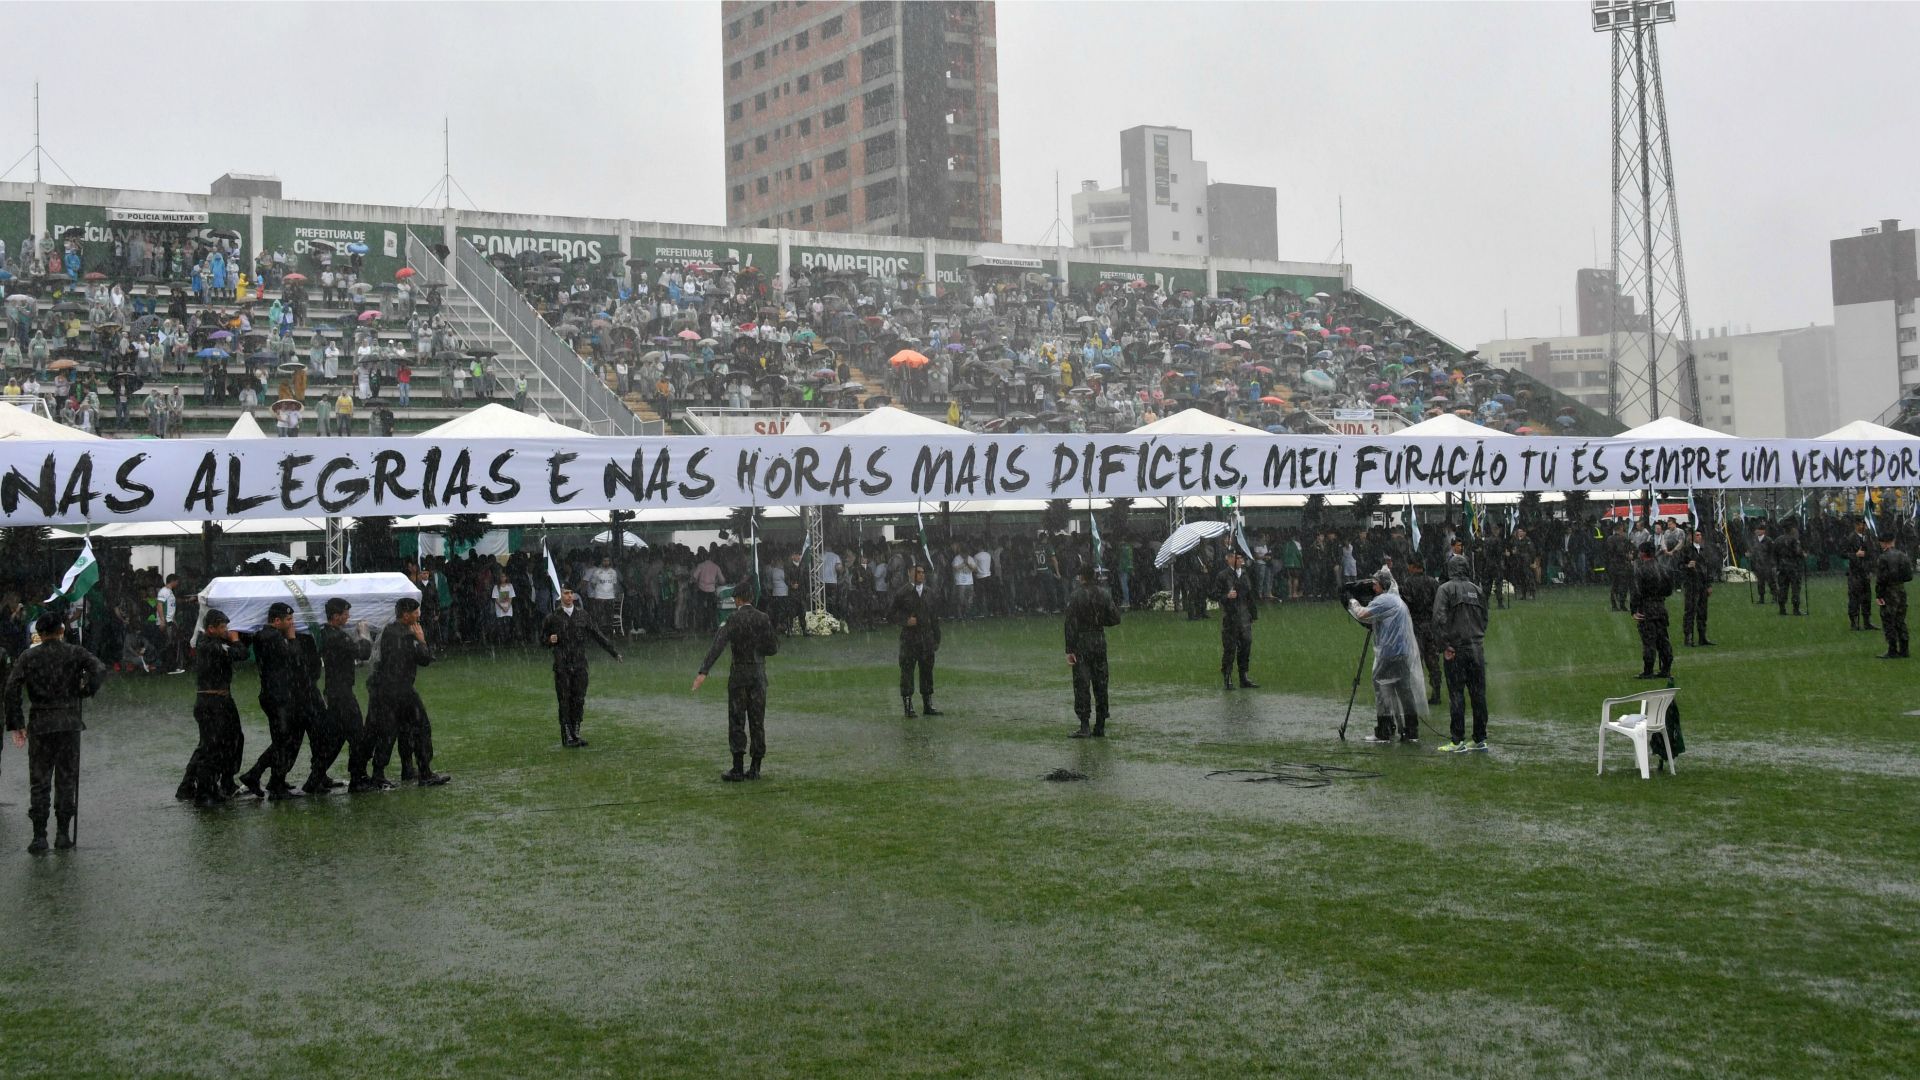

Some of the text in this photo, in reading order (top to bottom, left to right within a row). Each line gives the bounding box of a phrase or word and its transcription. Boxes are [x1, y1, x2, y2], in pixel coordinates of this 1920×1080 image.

[54, 221, 114, 242] PÍCIA
[296, 227, 366, 240] PREFEITURA DE
[655, 247, 713, 258] PREFEITURA DE
[801, 252, 909, 278] BOMBEIROS
[754, 416, 791, 435] SAÍ
[1370, 423, 1380, 436] 3
[1, 450, 155, 518] NAS
[184, 445, 521, 515] ALEGRIAS
[546, 449, 584, 505] E
[603, 445, 716, 503] NAS
[736, 446, 893, 499] HORAS
[910, 443, 1030, 496] MAIS
[1048, 436, 1247, 493] DIFÍCEIS,
[1263, 445, 1342, 490] MEU
[1520, 445, 1560, 488] TU
[1571, 441, 1609, 486] ÉS
[1620, 445, 1732, 485] SEMPRE
[1741, 446, 1780, 484] UM
